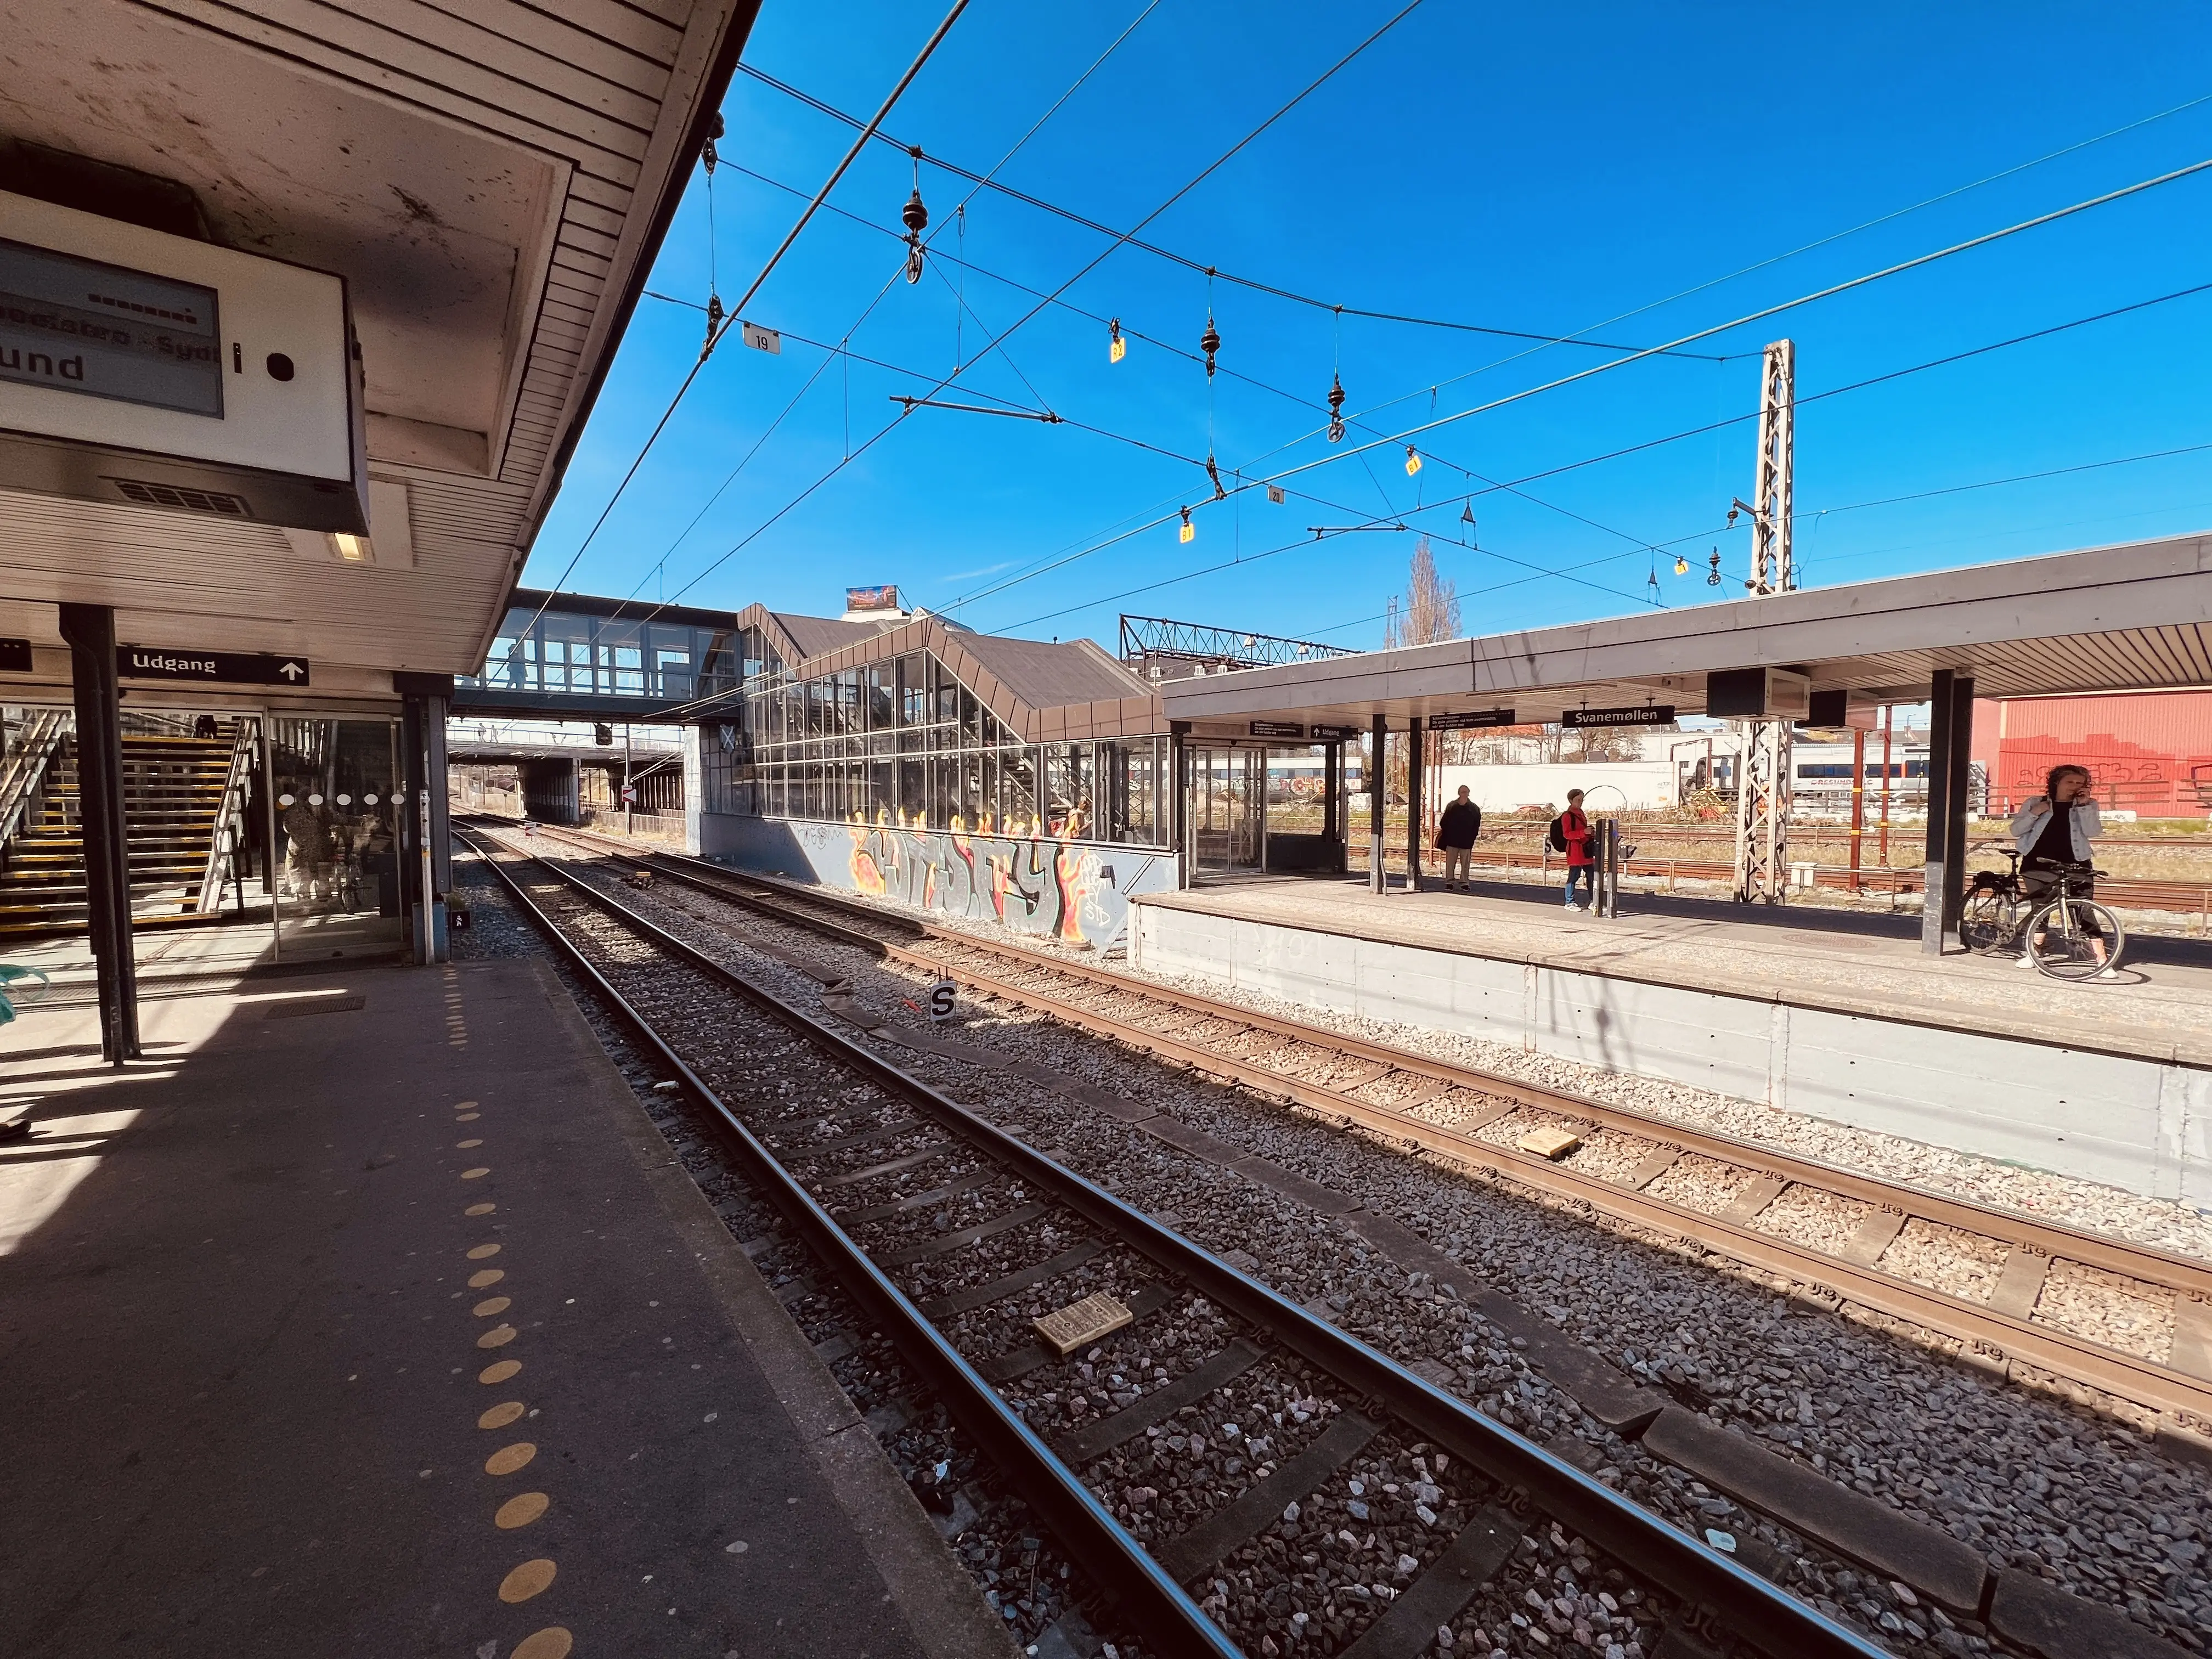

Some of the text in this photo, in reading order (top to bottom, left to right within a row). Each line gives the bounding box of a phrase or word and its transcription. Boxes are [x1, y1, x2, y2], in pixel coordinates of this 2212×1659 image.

[755, 335, 768, 350] 19
[1273, 491, 1280, 503] 20
[133, 654, 216, 674] Udgang
[1575, 710, 1657, 723] Svanemøllen
[932, 986, 956, 1016] S
